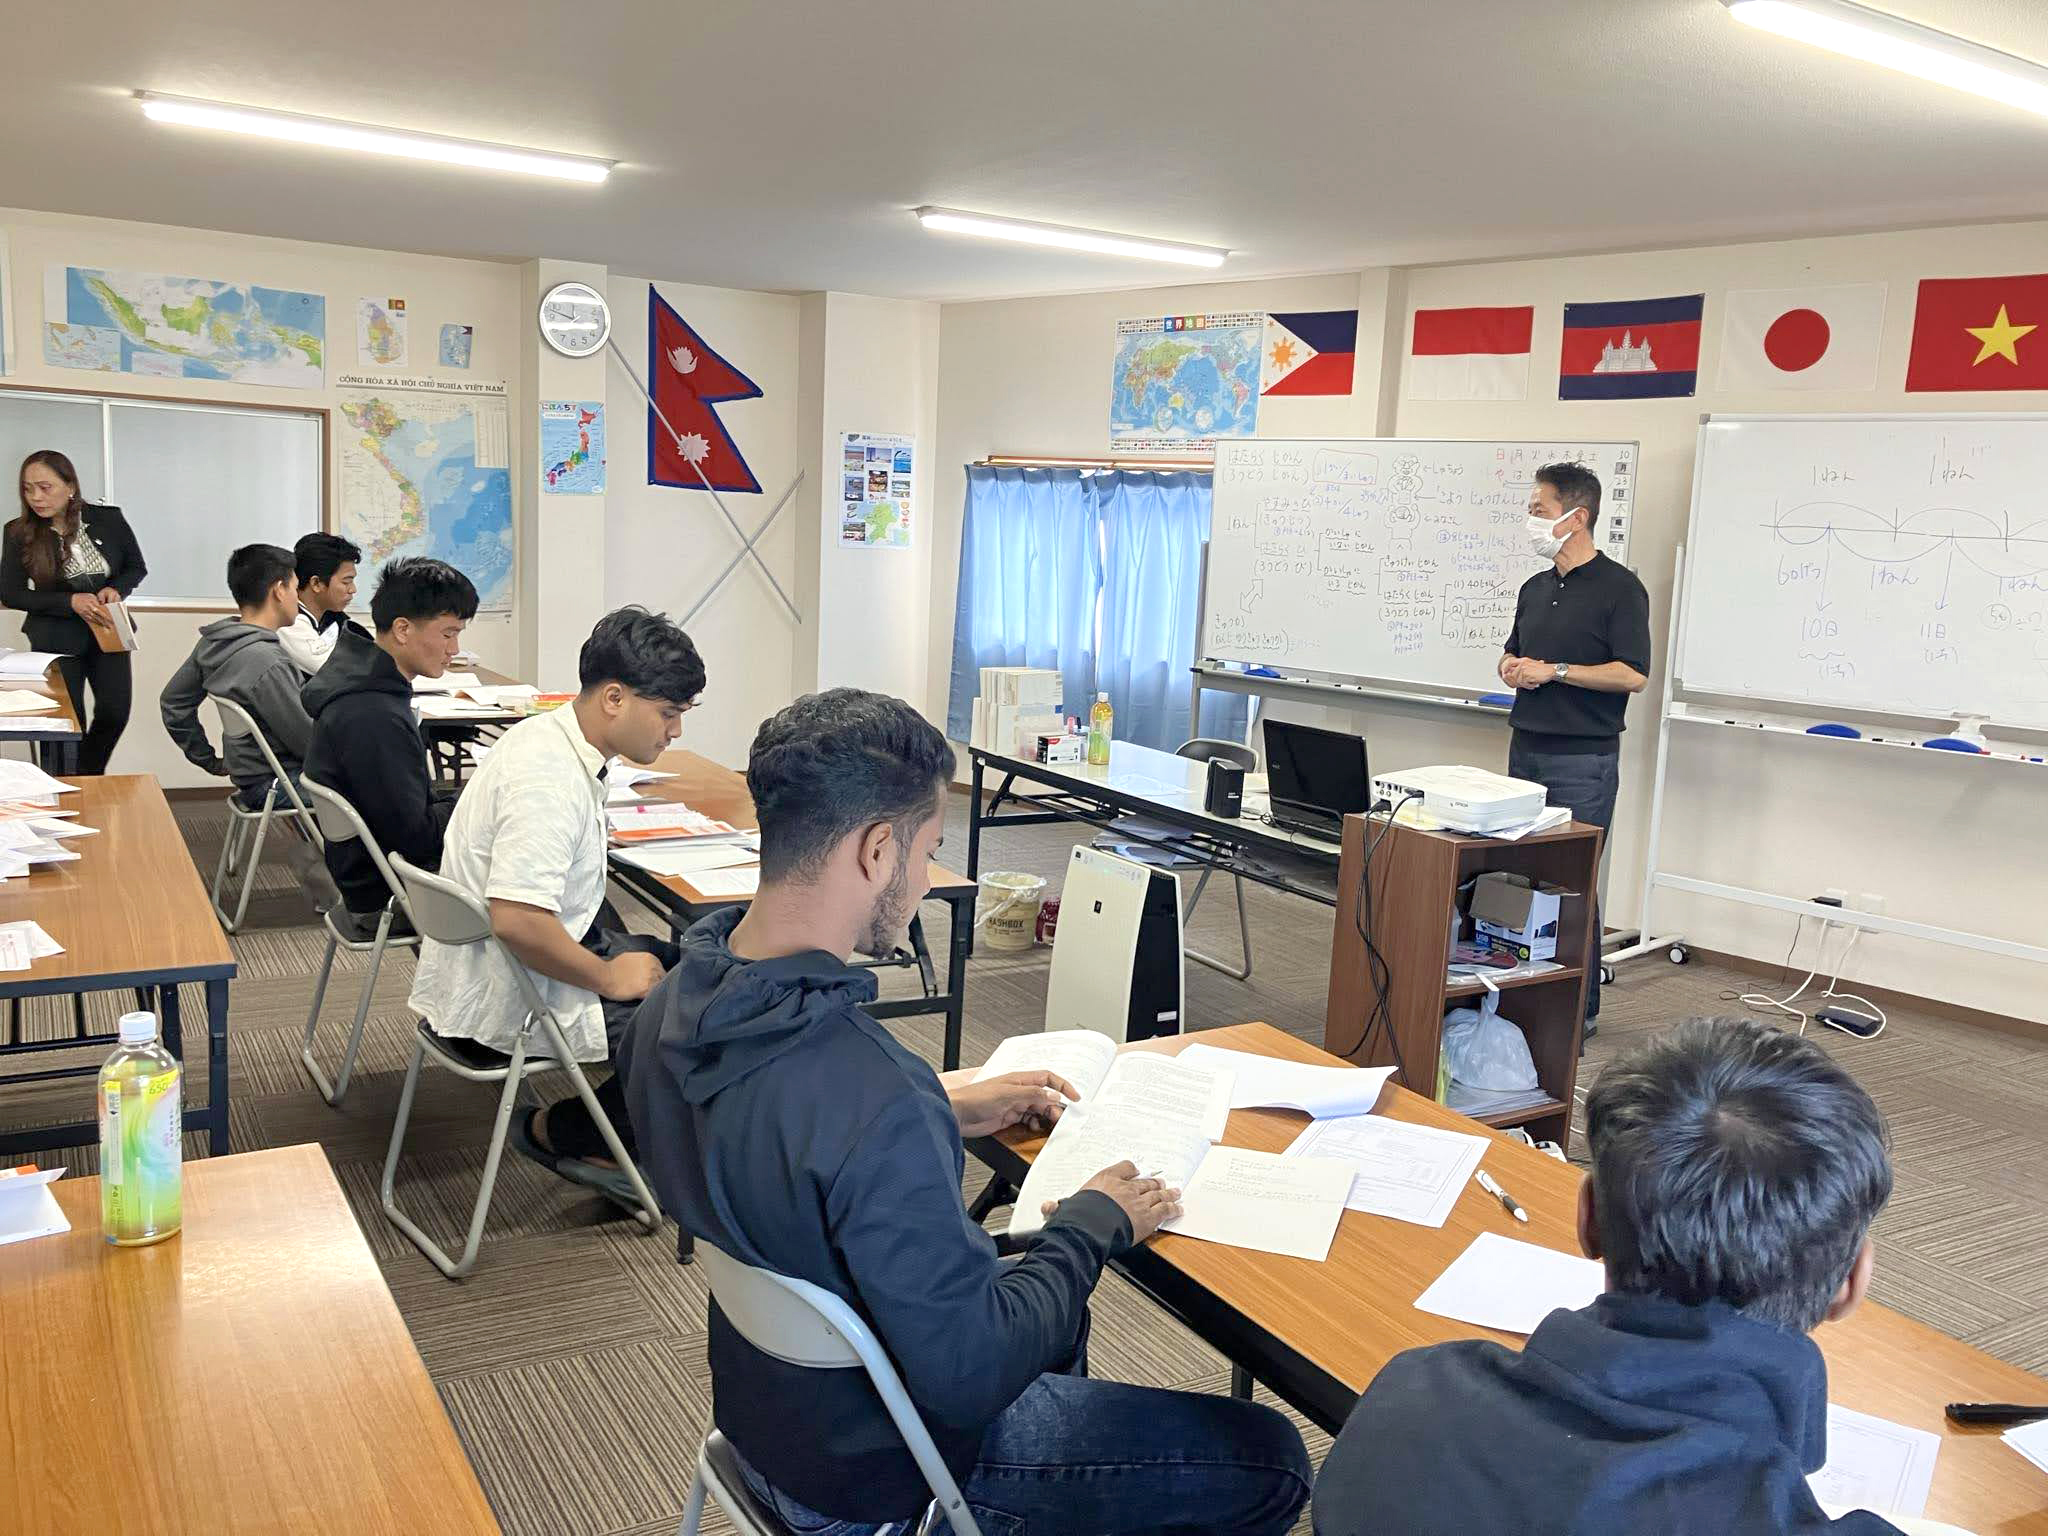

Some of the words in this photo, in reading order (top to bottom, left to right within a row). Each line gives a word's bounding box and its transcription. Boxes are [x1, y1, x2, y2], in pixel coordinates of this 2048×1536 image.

[339, 375, 364, 385] CỘNG
[365, 376, 384, 386] HÒA
[386, 377, 400, 387] XÃ
[401, 378, 417, 388] HỘI
[418, 378, 435, 389] CHỦ
[437, 381, 463, 391] NGHĨA
[464, 382, 484, 392] VIỆT
[485, 384, 504, 393] NAM
